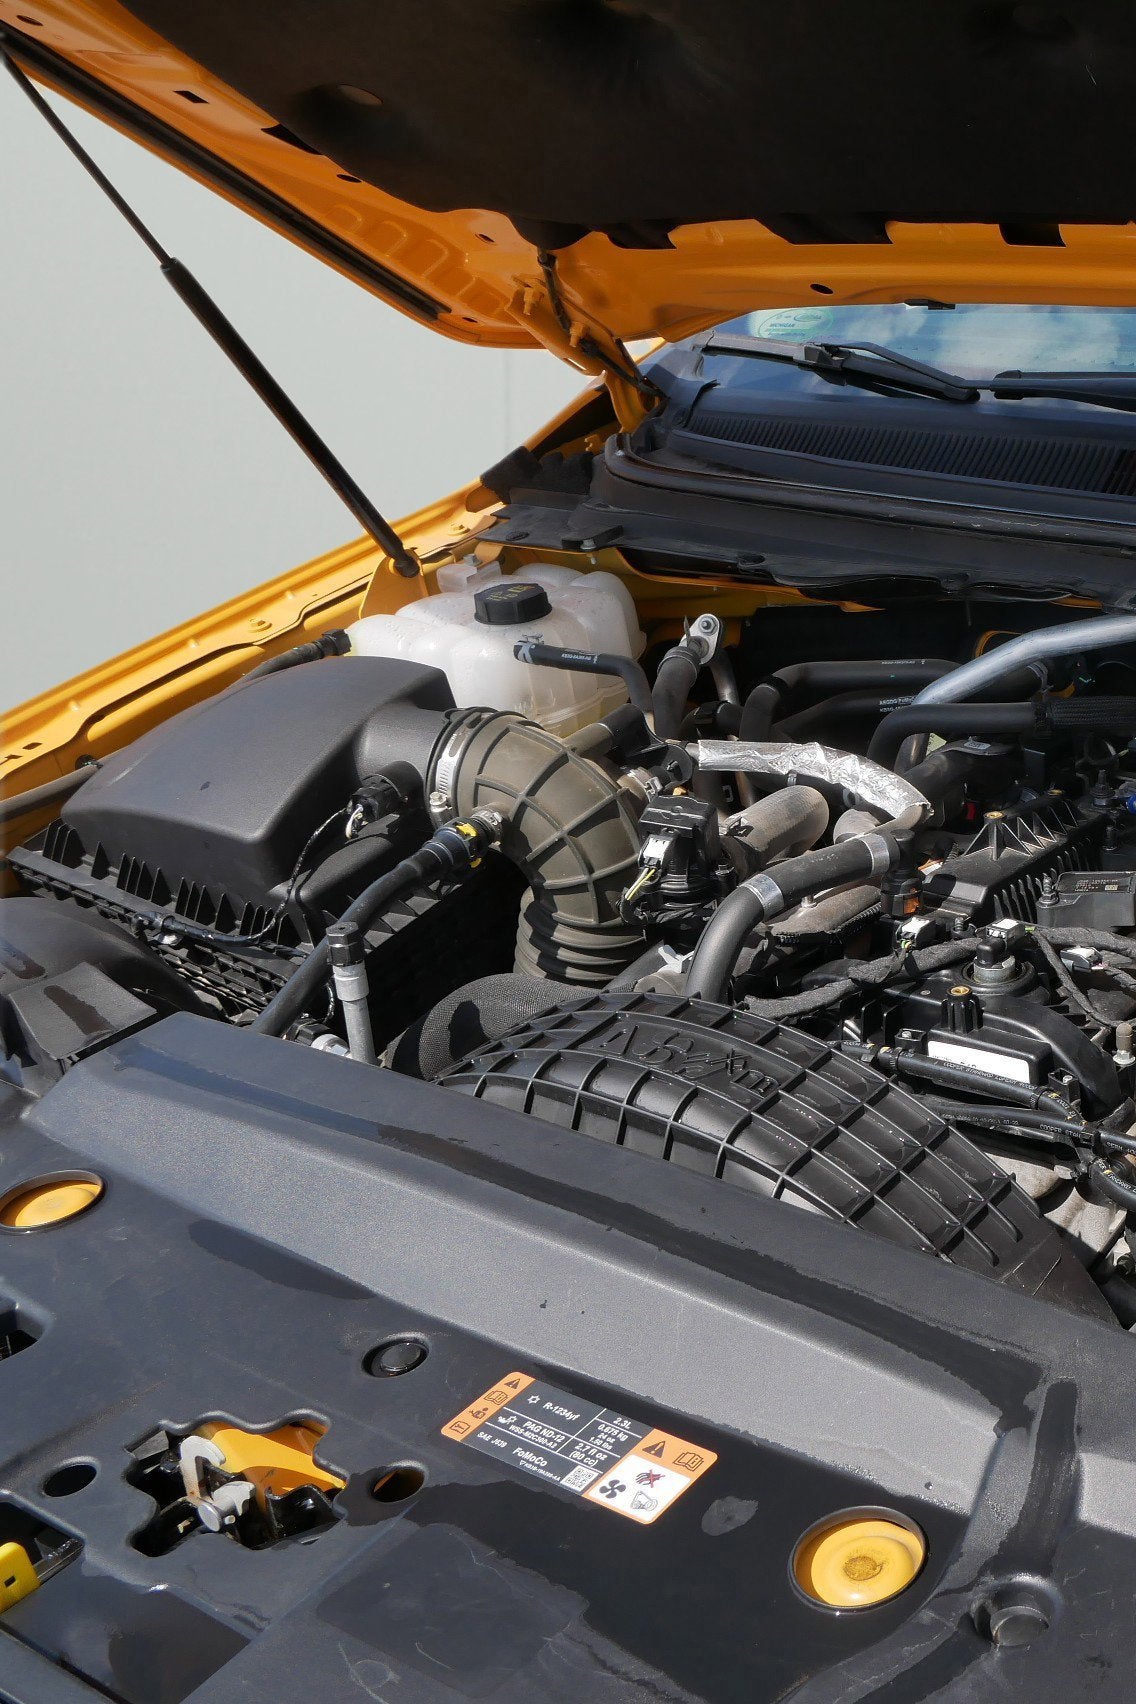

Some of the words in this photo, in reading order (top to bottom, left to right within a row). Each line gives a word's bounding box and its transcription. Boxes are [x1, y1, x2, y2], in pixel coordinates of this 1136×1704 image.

[542, 1401, 580, 1421] R-1234yf
[613, 1417, 632, 1429] 2.3L
[477, 1431, 493, 1442] SAE
[523, 1421, 542, 1433] PAG
[540, 1428, 566, 1443] ND-12
[616, 1432, 629, 1442] kg
[512, 1446, 548, 1467] FoMoCo
[573, 1441, 591, 1453] 2.7
[596, 1452, 608, 1461] oz
[583, 1457, 599, 1468] cc)
